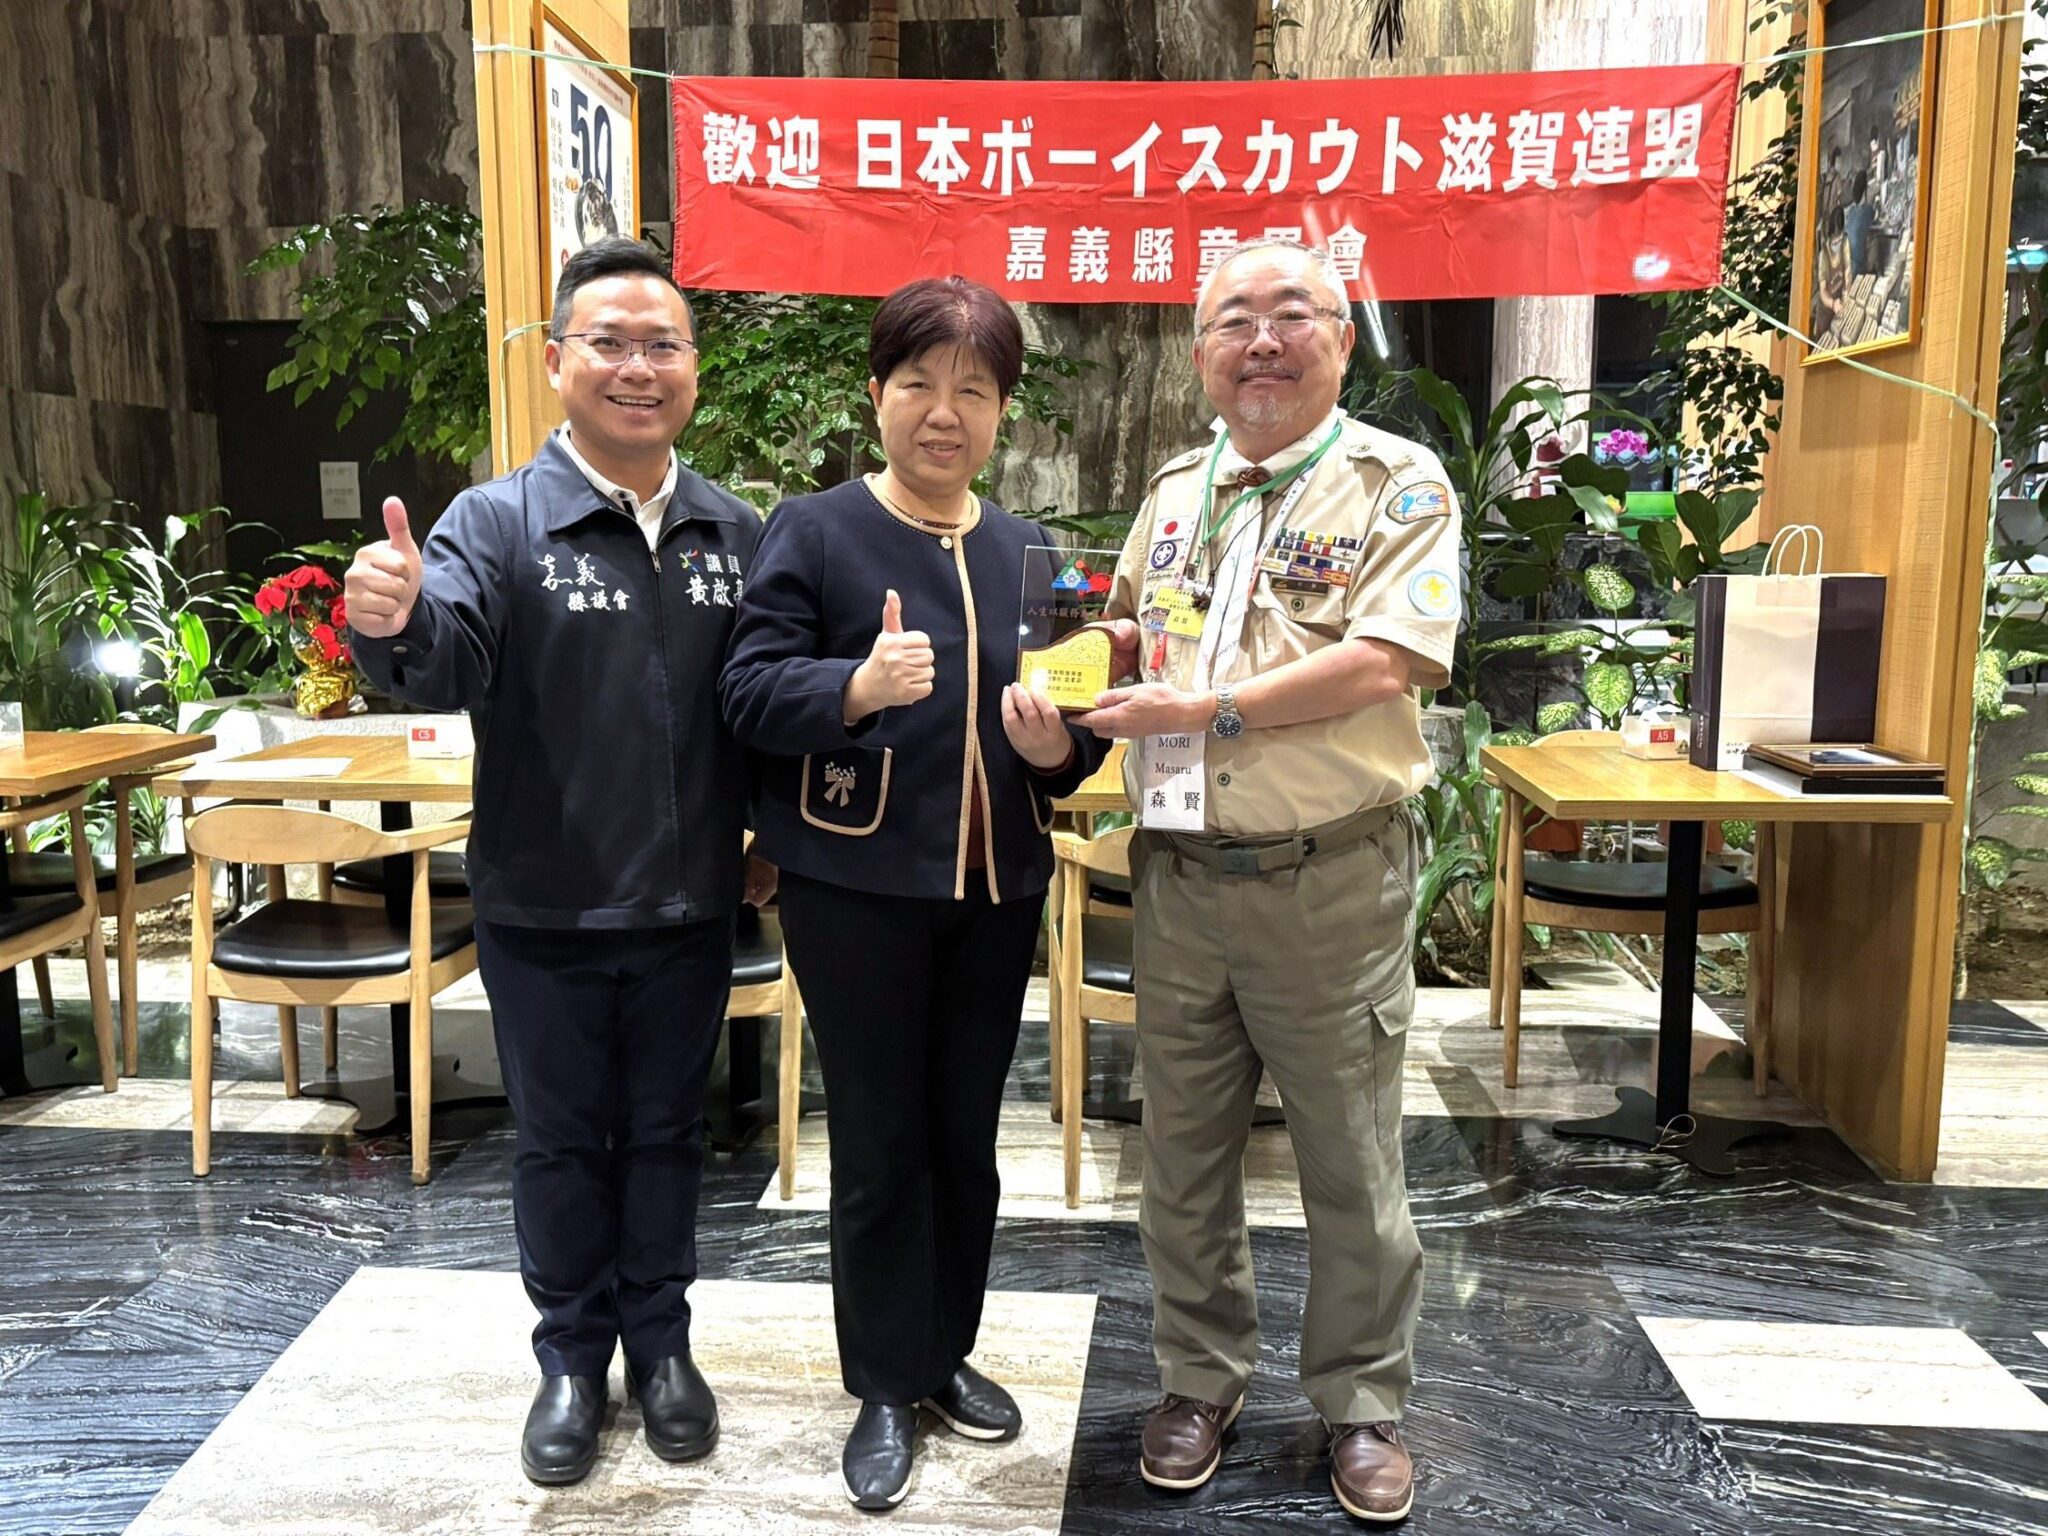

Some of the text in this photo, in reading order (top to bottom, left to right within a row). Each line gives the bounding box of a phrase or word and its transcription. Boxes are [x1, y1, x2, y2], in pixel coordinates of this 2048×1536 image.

[702, 103, 1703, 198] 歡迎 日本ボーイスカウト滋賀連盟
[1005, 224, 1367, 283] 嘉義縣童會
[418, 729, 431, 740] C5
[1656, 730, 1669, 741] A5
[1158, 736, 1191, 749] MORI
[1155, 762, 1192, 775] Masaru
